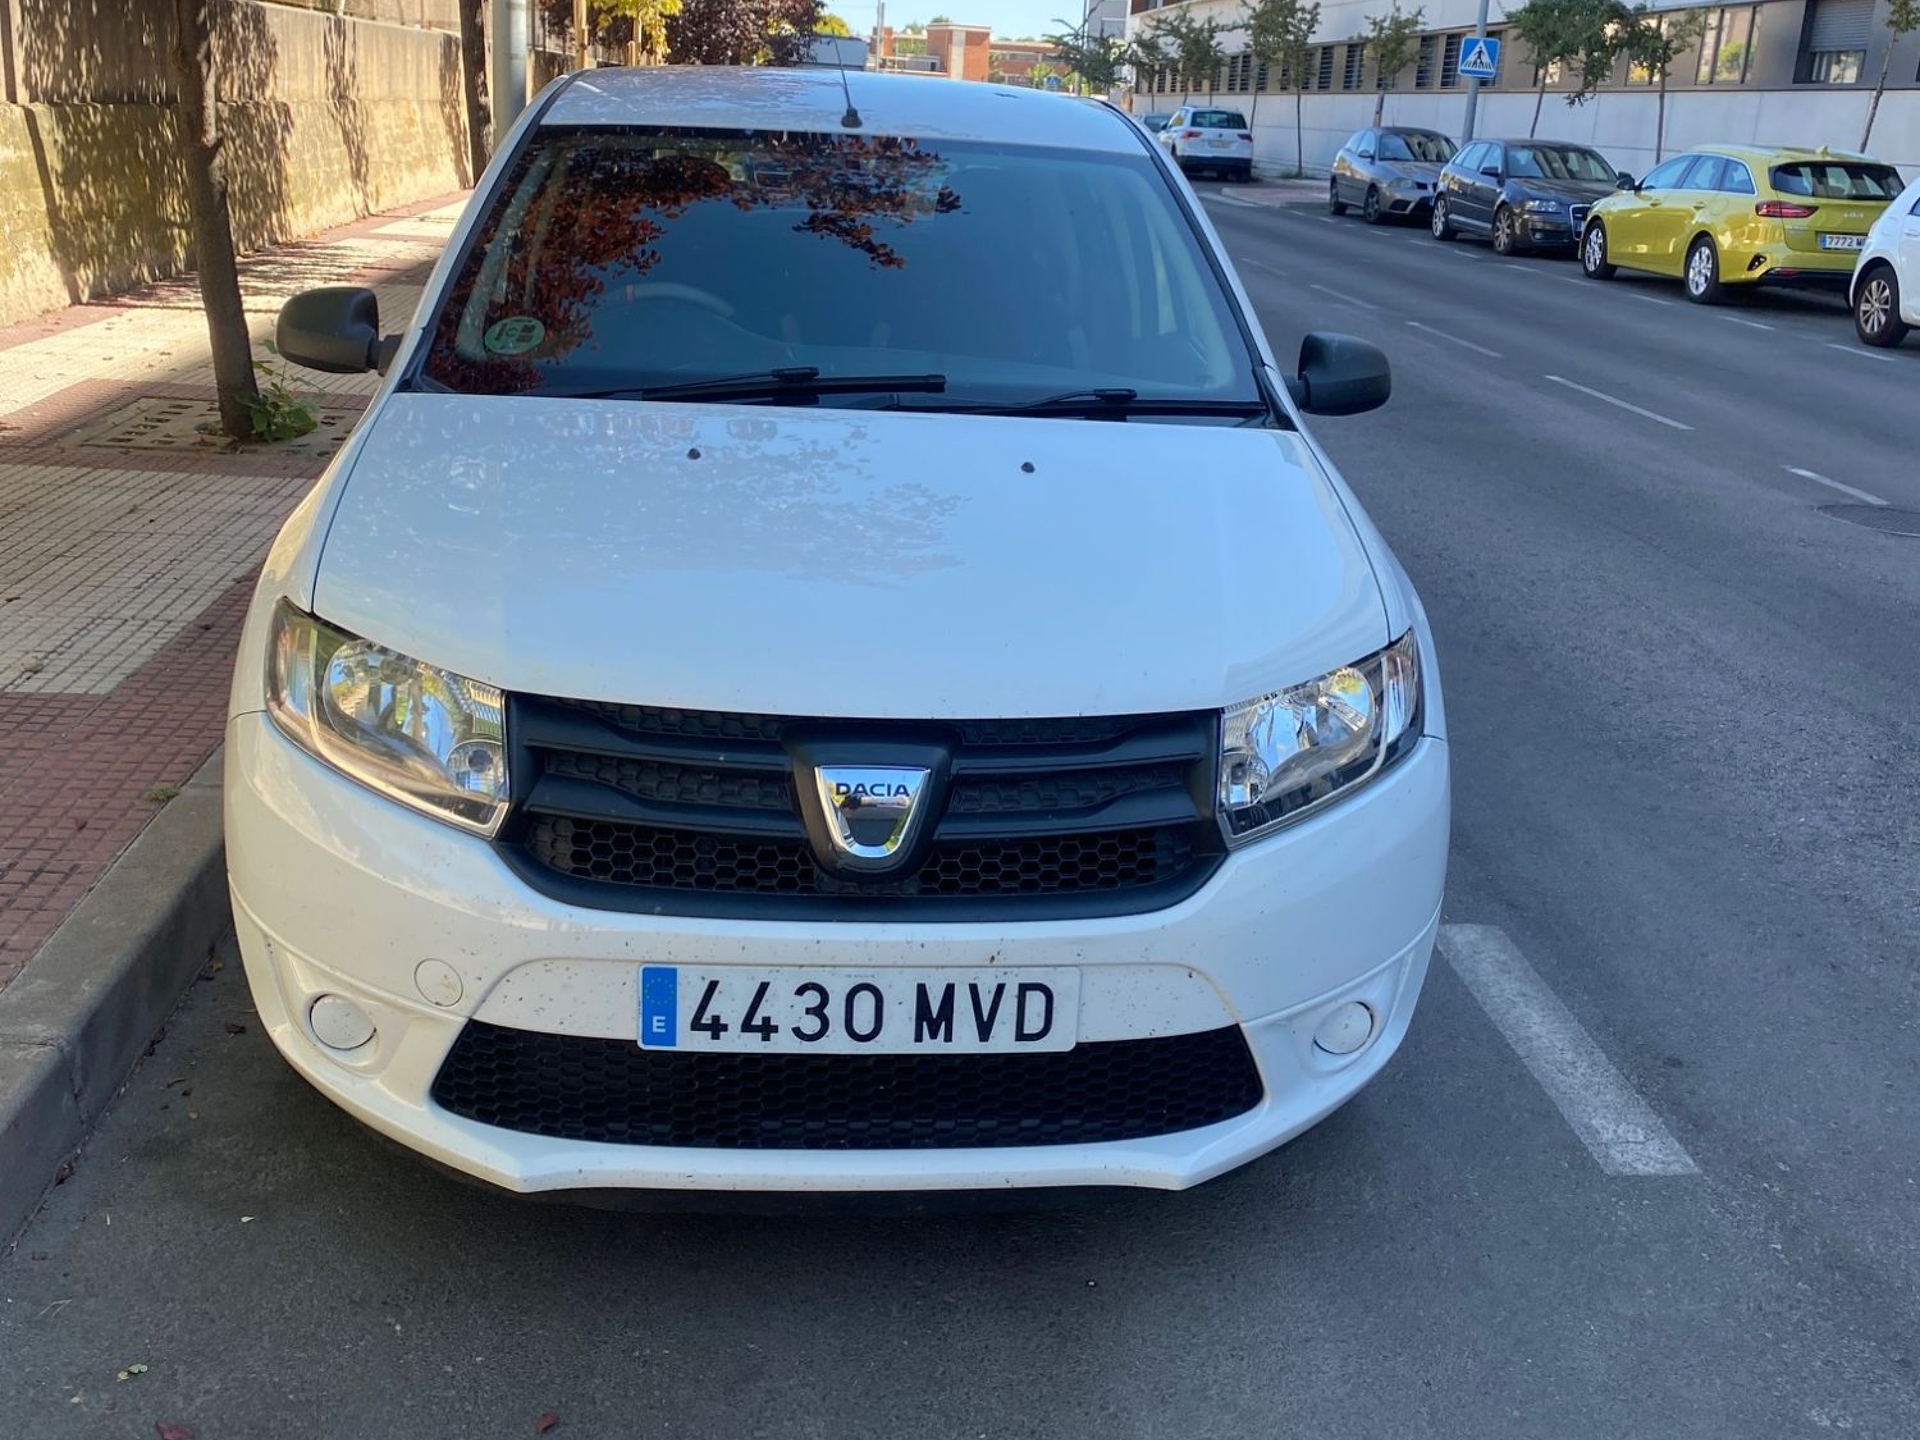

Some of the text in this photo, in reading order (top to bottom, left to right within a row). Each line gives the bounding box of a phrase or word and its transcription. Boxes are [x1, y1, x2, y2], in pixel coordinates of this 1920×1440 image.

[1828, 236, 1854, 247] 7772
[835, 782, 910, 798] DACIA
[690, 980, 1055, 1043] 4430 MVD
[652, 1015, 667, 1033] E
